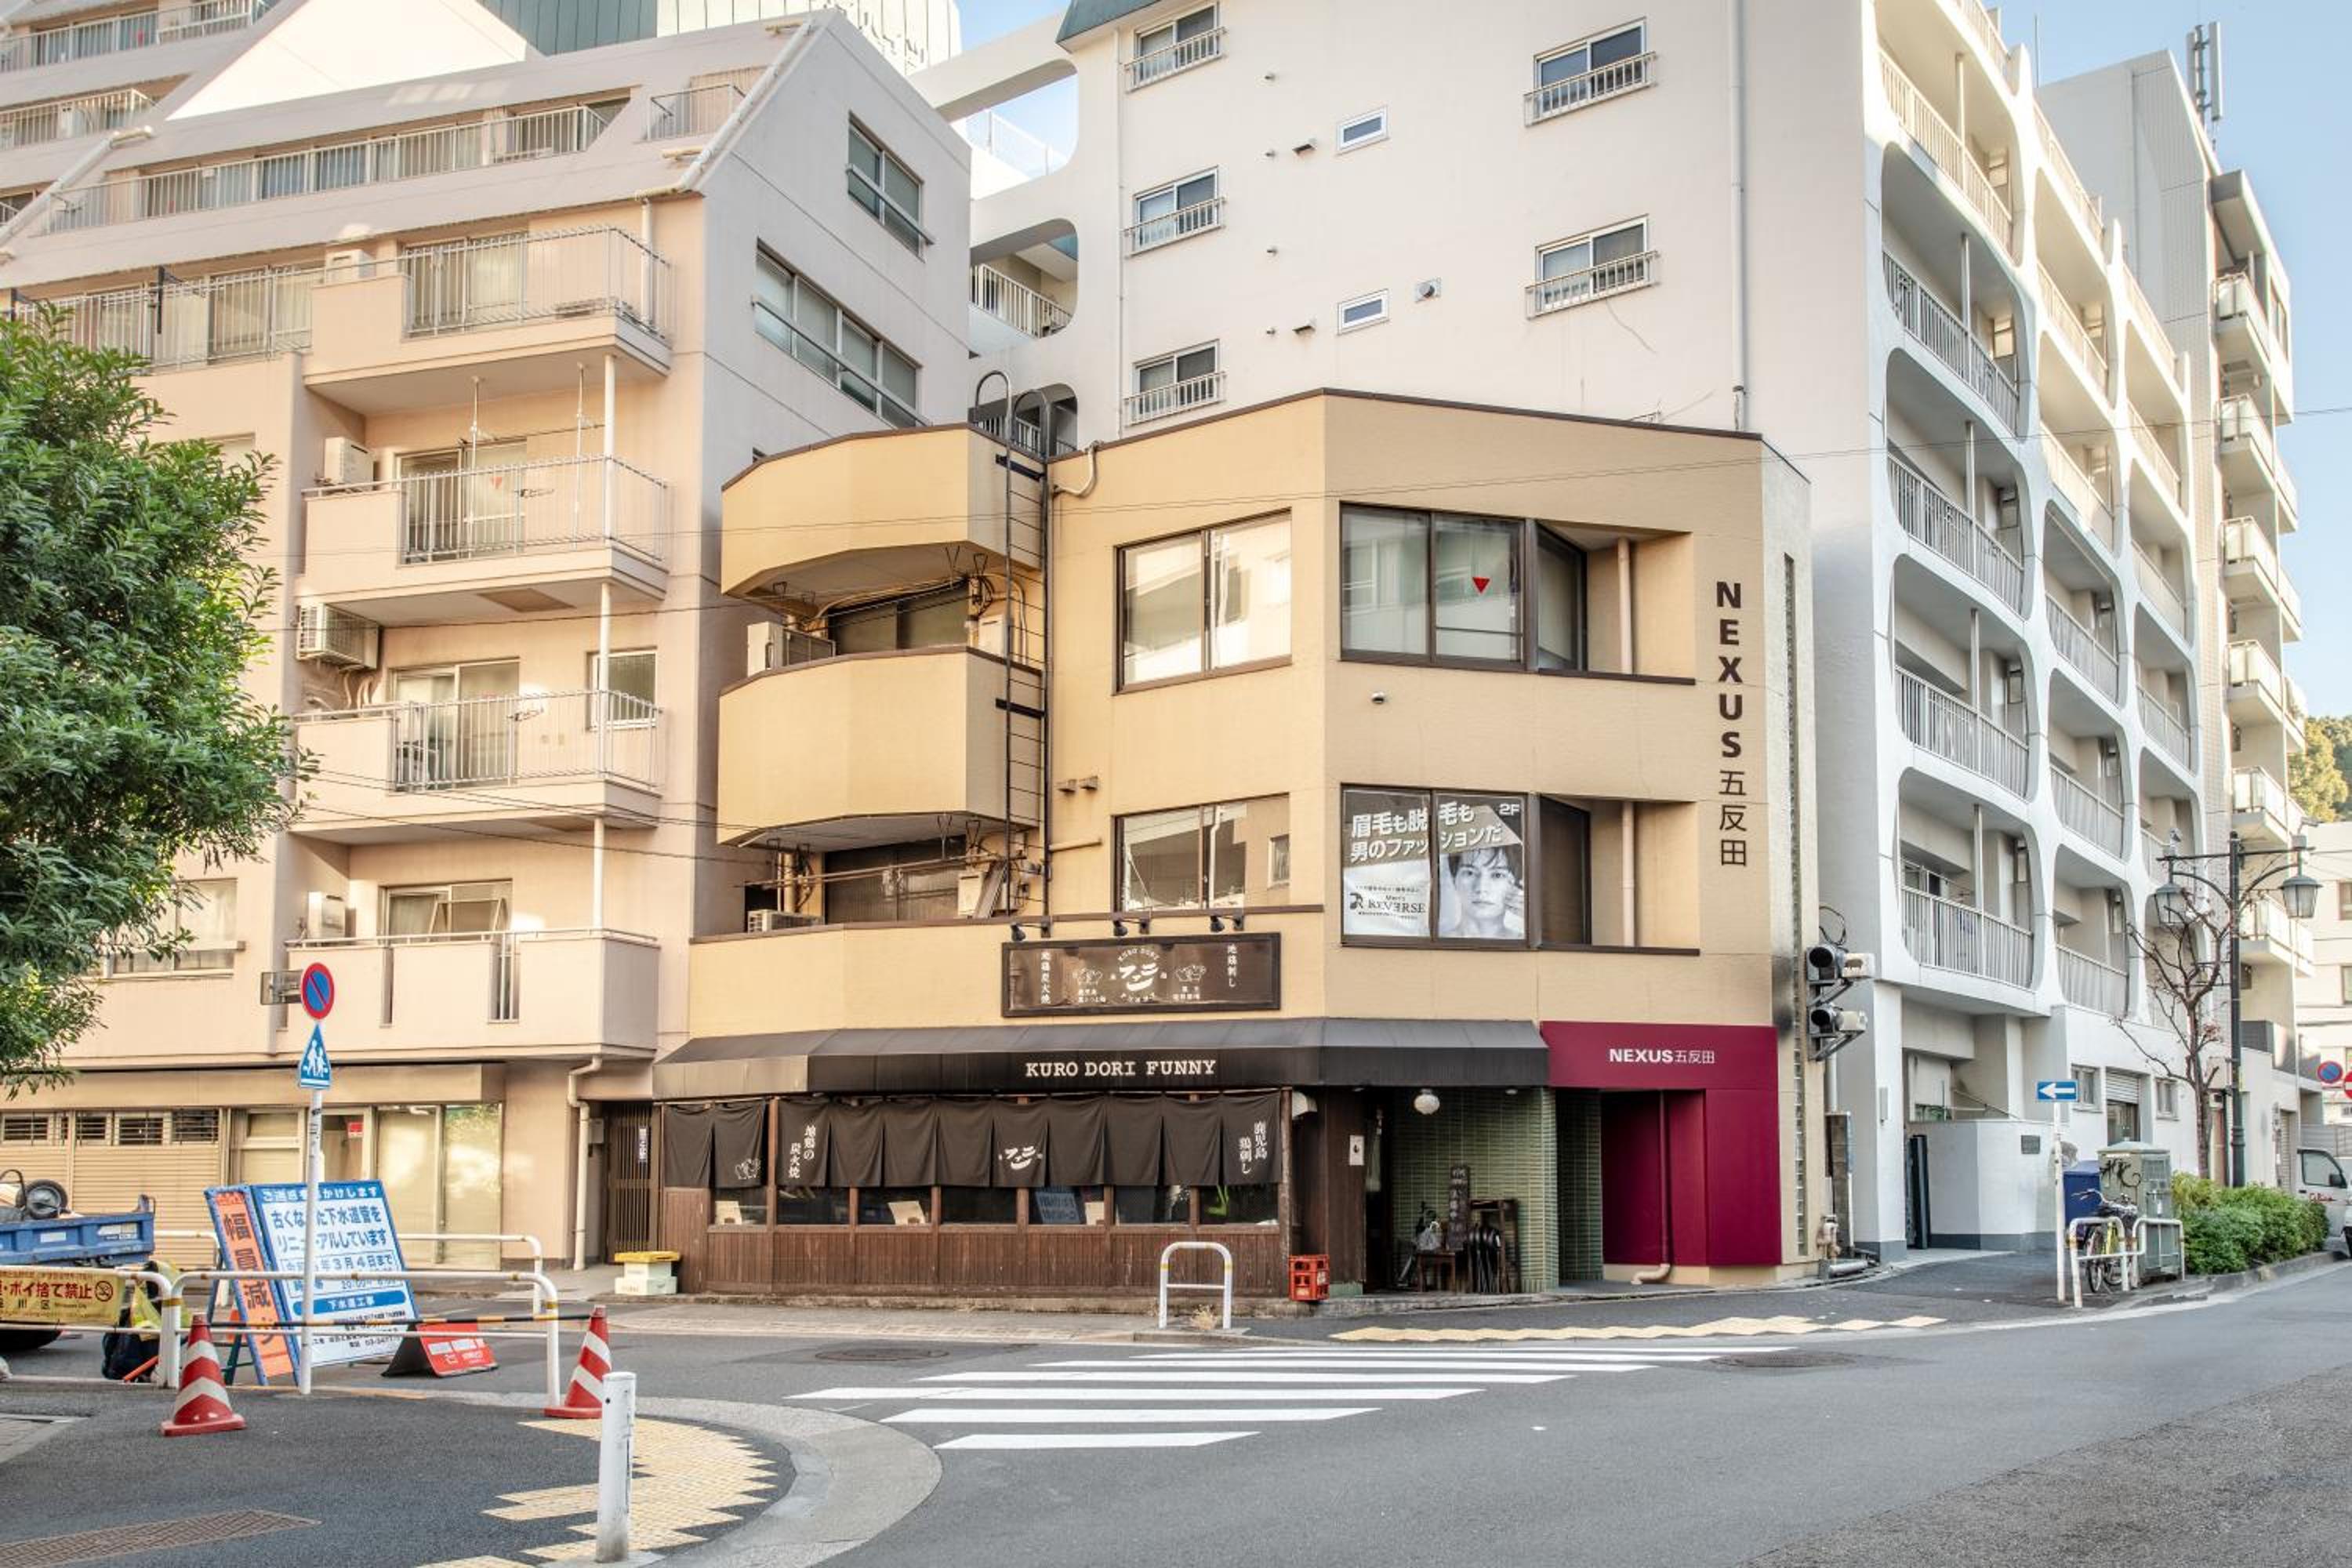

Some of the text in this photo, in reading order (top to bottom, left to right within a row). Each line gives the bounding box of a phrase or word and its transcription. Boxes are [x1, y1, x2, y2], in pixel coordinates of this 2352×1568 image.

[1499, 804, 1520, 815] 2F
[1025, 1060, 1216, 1076] KURO DORI FUNNY
[271, 1205, 382, 1229] 古くなた下水道管を
[278, 1229, 387, 1252] リニアルしています
[0, 1279, 92, 1299] ・ポイ捨て禁止
